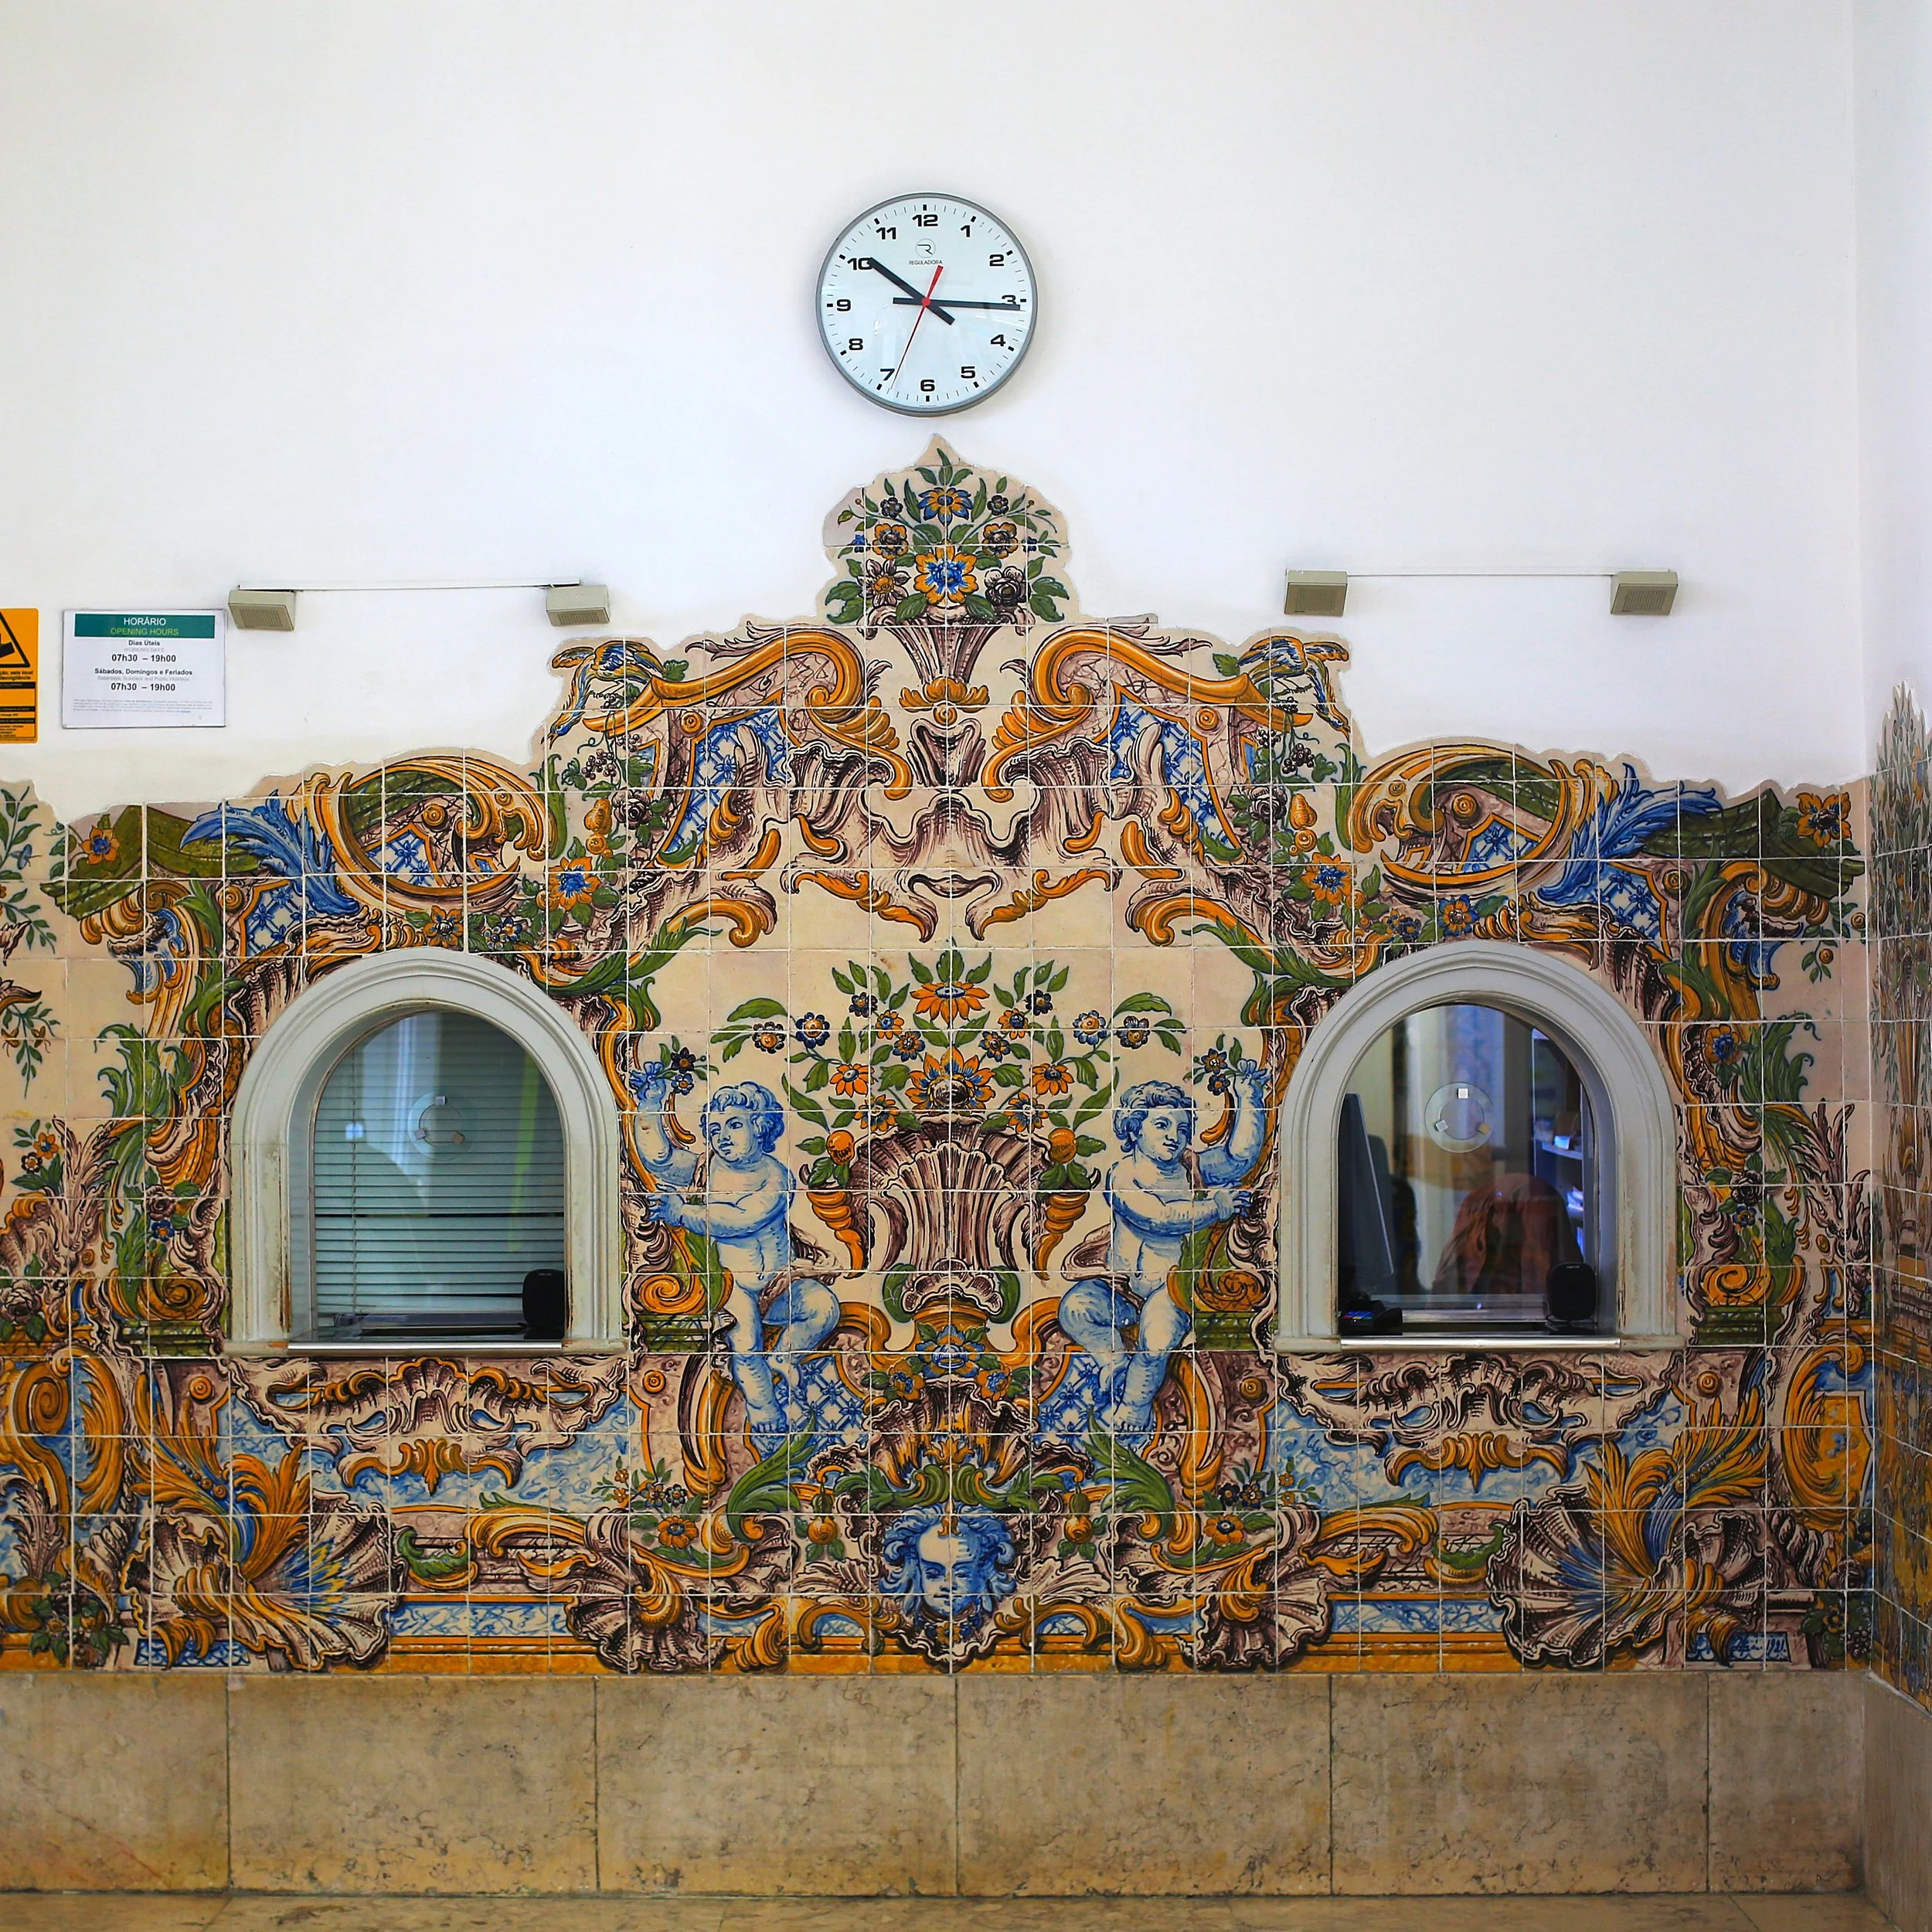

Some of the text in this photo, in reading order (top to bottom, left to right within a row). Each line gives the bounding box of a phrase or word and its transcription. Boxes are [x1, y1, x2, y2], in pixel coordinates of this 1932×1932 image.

[912, 214, 938, 227] 12
[876, 226, 896, 240] 11
[960, 225, 971, 237] 1
[989, 253, 1004, 267] 2
[836, 298, 851, 311] 9
[849, 338, 863, 351] 8
[990, 334, 1005, 347] 4
[879, 368, 895, 381] 7
[961, 366, 975, 379] 5
[920, 379, 935, 392] 6
[124, 617, 166, 626] HORÁRIO
